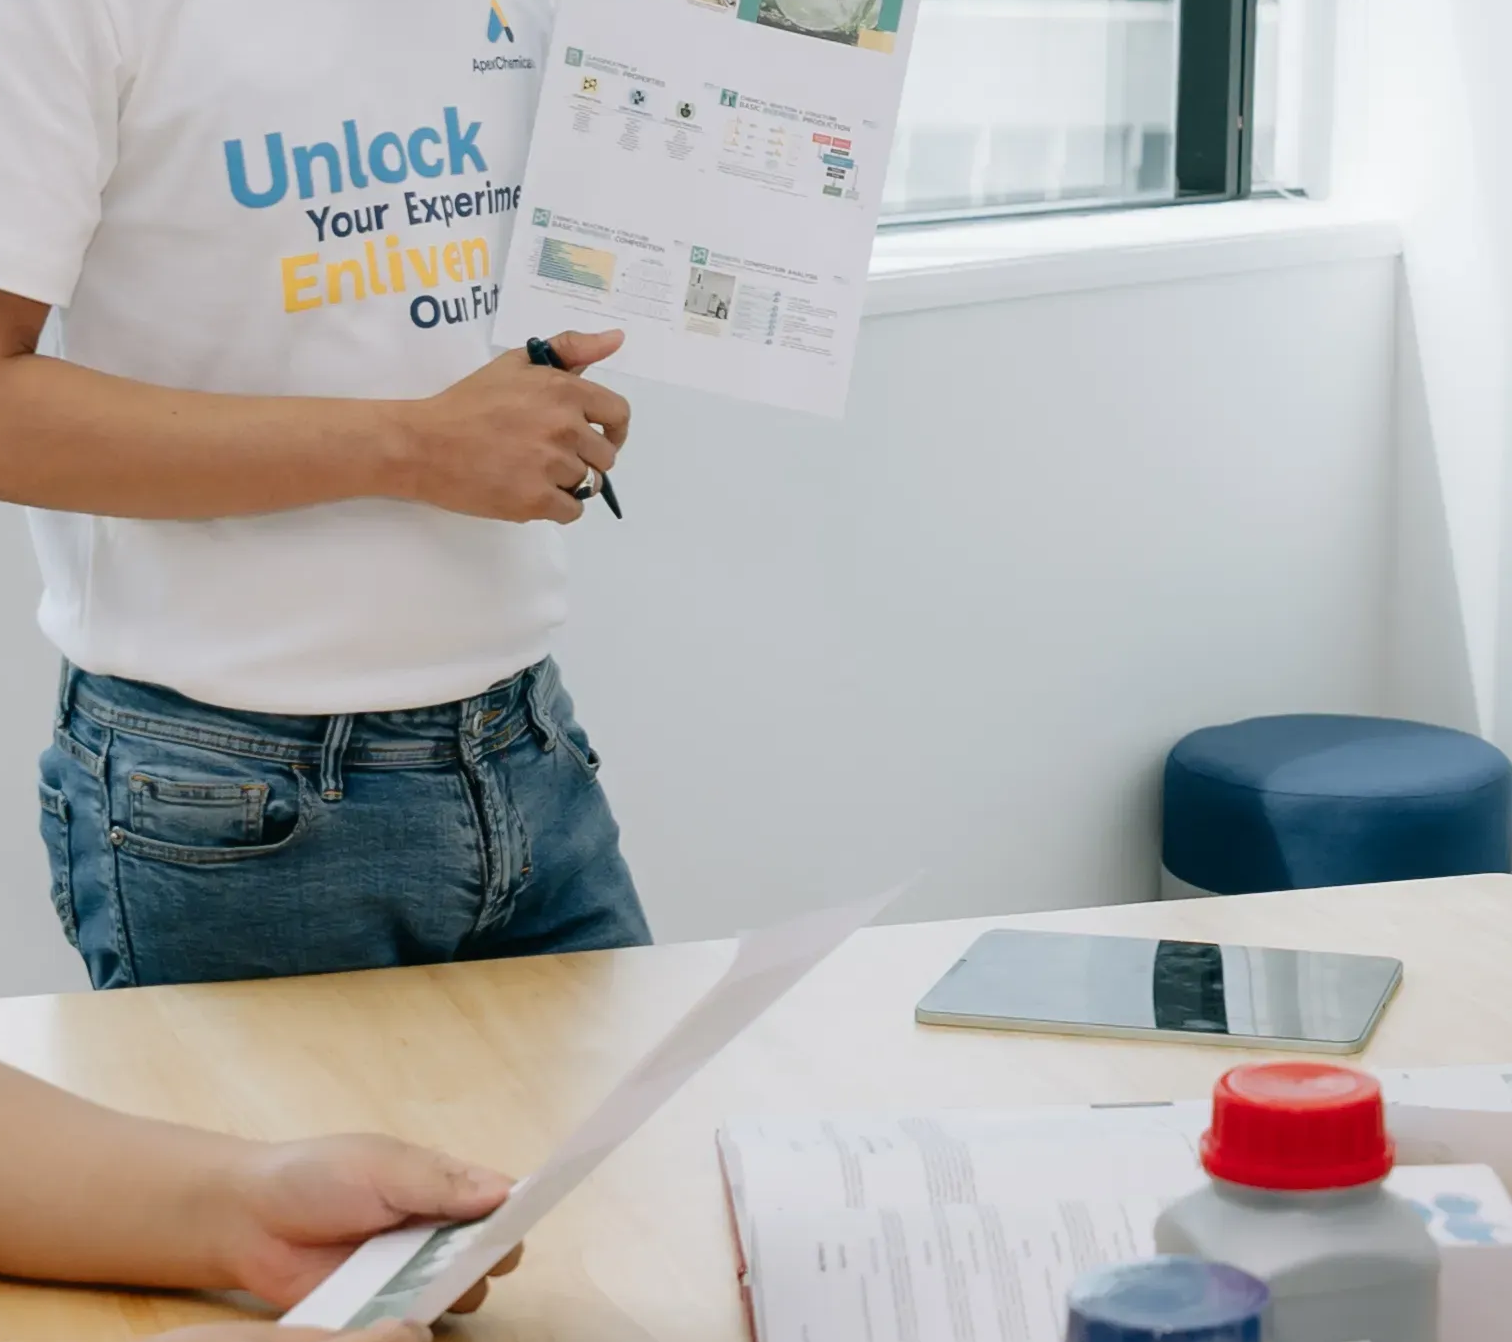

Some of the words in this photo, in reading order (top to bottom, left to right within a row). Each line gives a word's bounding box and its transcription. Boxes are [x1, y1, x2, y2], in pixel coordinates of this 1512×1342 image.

[739, 101, 761, 112] BASIC
[802, 116, 851, 132] PRODUCTION
[224, 106, 488, 209] Unlock
[306, 204, 389, 242] Your
[551, 220, 573, 232] BASIC
[614, 236, 665, 253] COMPOSITION
[281, 234, 489, 314] Enliven
[471, 284, 499, 320] Fut
